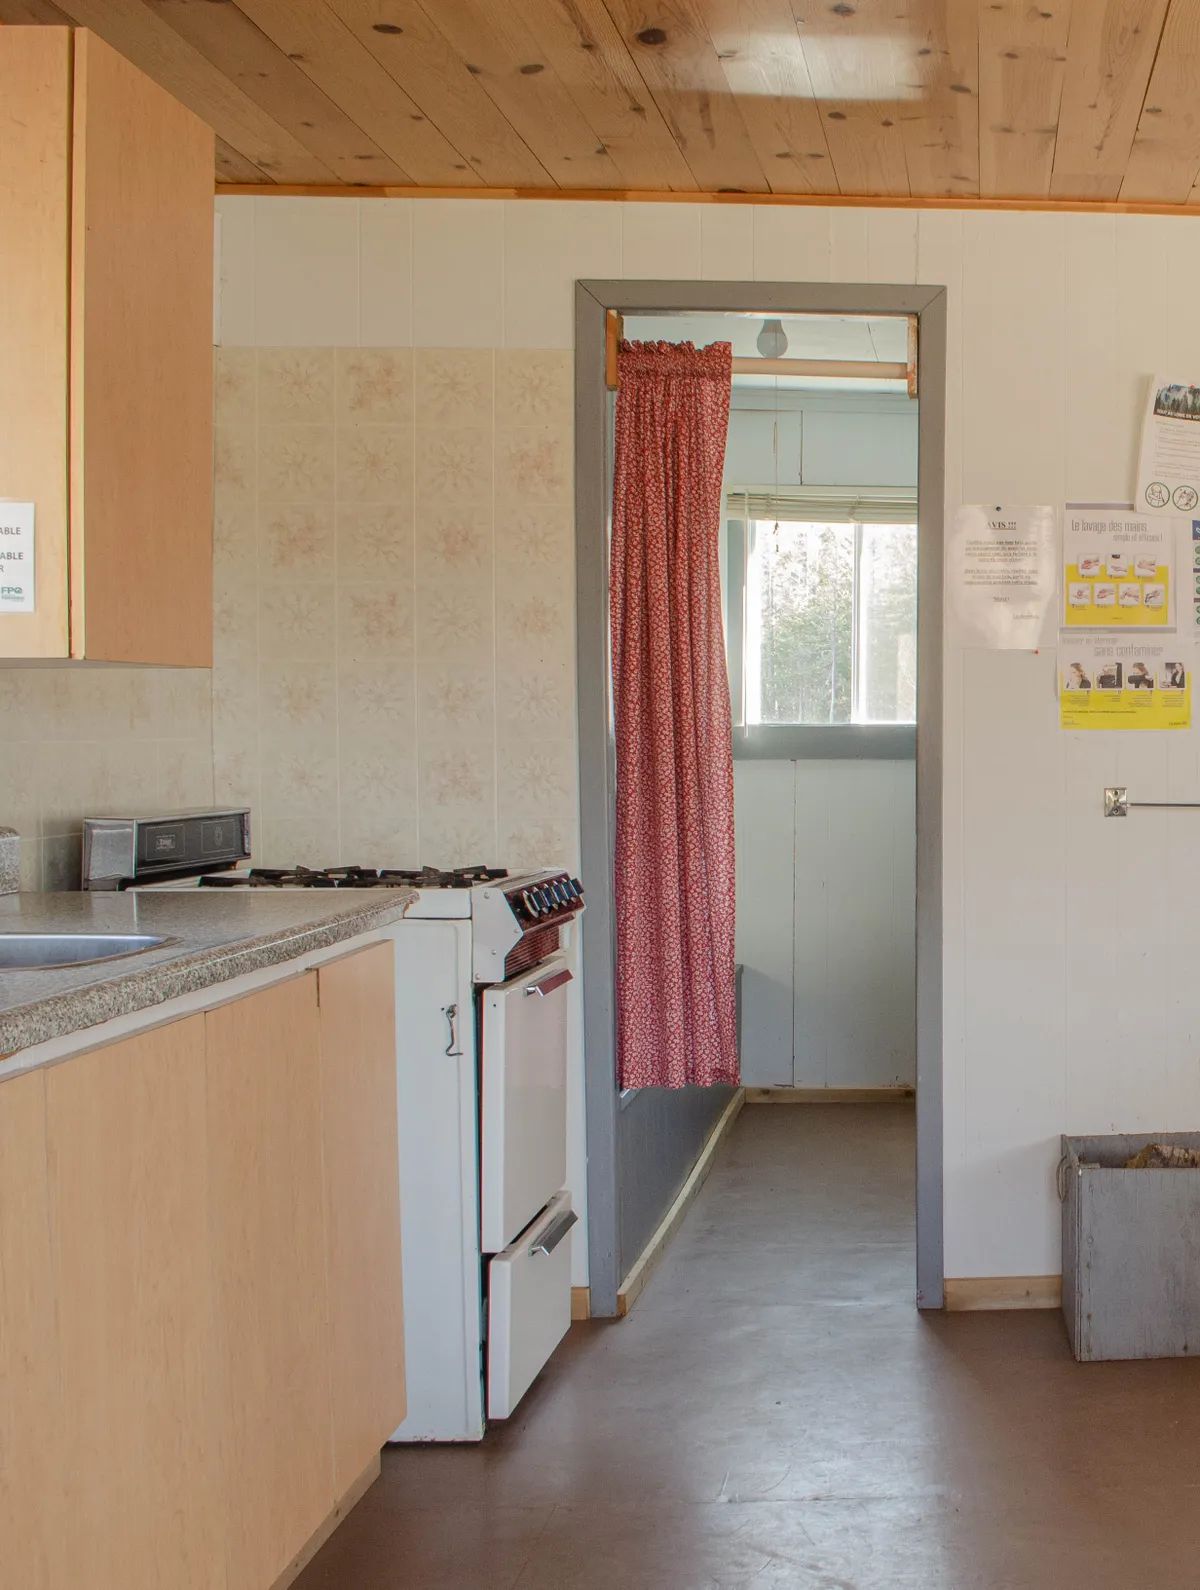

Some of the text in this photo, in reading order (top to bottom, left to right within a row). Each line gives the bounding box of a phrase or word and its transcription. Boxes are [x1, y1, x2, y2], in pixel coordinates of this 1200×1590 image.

[986, 521, 1006, 529] AVIS
[1071, 519, 1148, 534] Le lavage des mains
